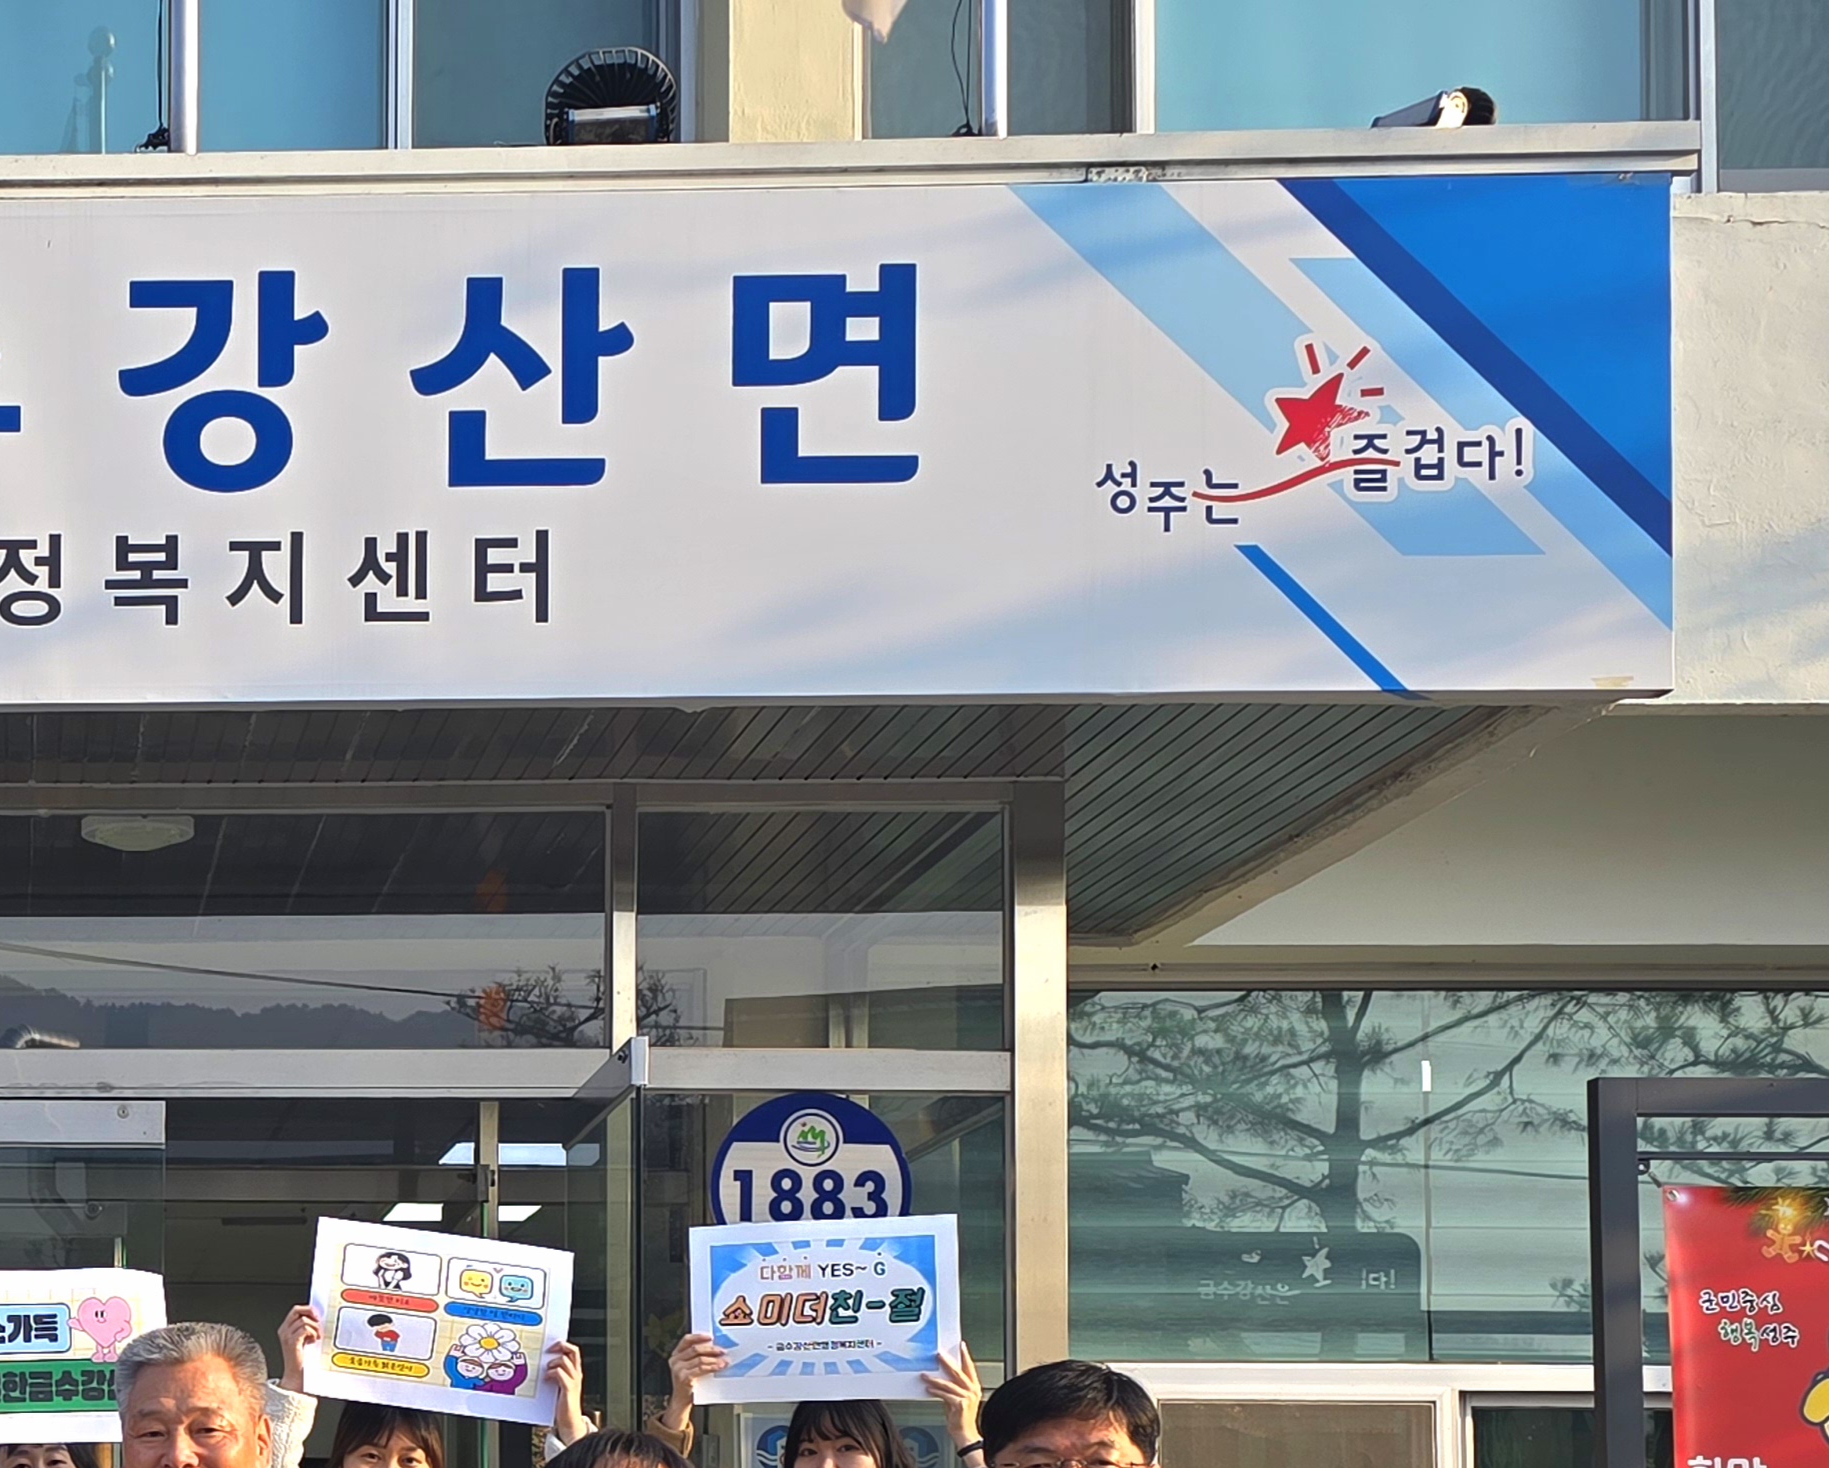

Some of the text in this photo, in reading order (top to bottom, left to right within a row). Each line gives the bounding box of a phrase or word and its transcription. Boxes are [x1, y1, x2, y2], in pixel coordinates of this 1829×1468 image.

[1095, 426, 1524, 532] 성주는 즐겁다!
[732, 1169, 889, 1223] 1883
[760, 1263, 812, 1281] 다함께
[873, 1261, 886, 1277] G
[1699, 1288, 1784, 1315] 군민중심
[1718, 1318, 1800, 1352] 행복성주
